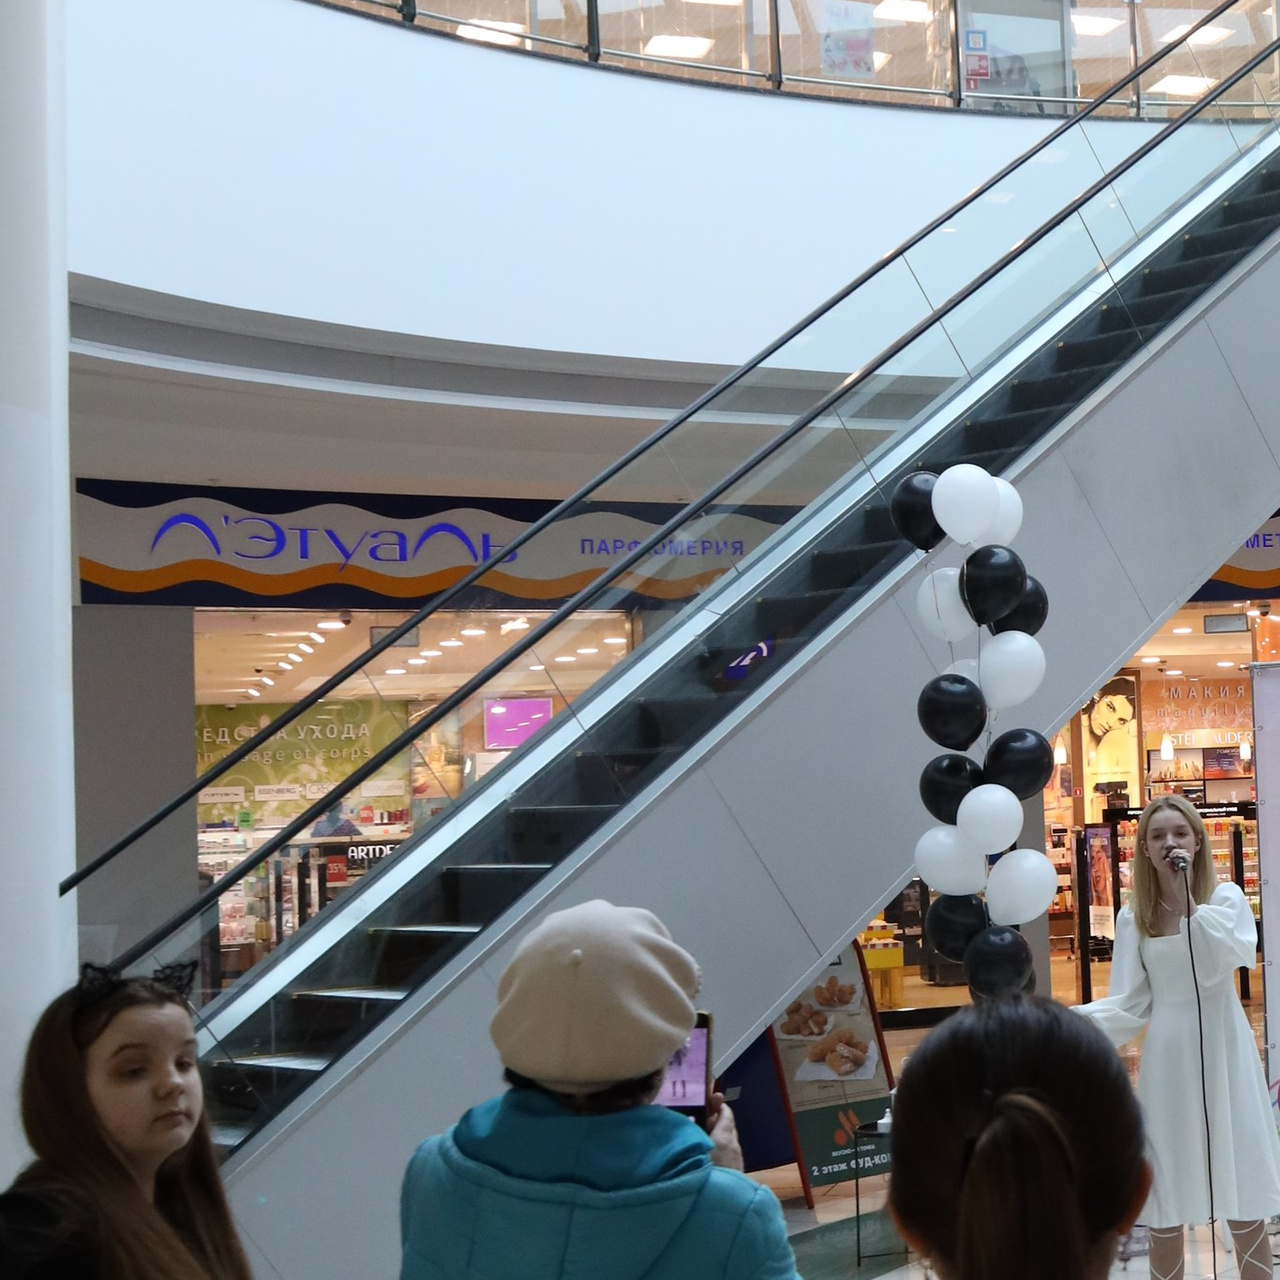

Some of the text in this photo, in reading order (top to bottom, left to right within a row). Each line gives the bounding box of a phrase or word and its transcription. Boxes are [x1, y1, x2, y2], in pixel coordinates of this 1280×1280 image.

[1169, 685, 1245, 699] МАКИЯ
[1156, 704, 1252, 719] maquilla
[297, 723, 371, 739] УХОДА
[293, 747, 312, 760] et
[320, 746, 371, 761] corps
[347, 844, 401, 859] ARTDE
[812, 1166, 819, 1176] 2
[821, 1162, 848, 1174] этаж
